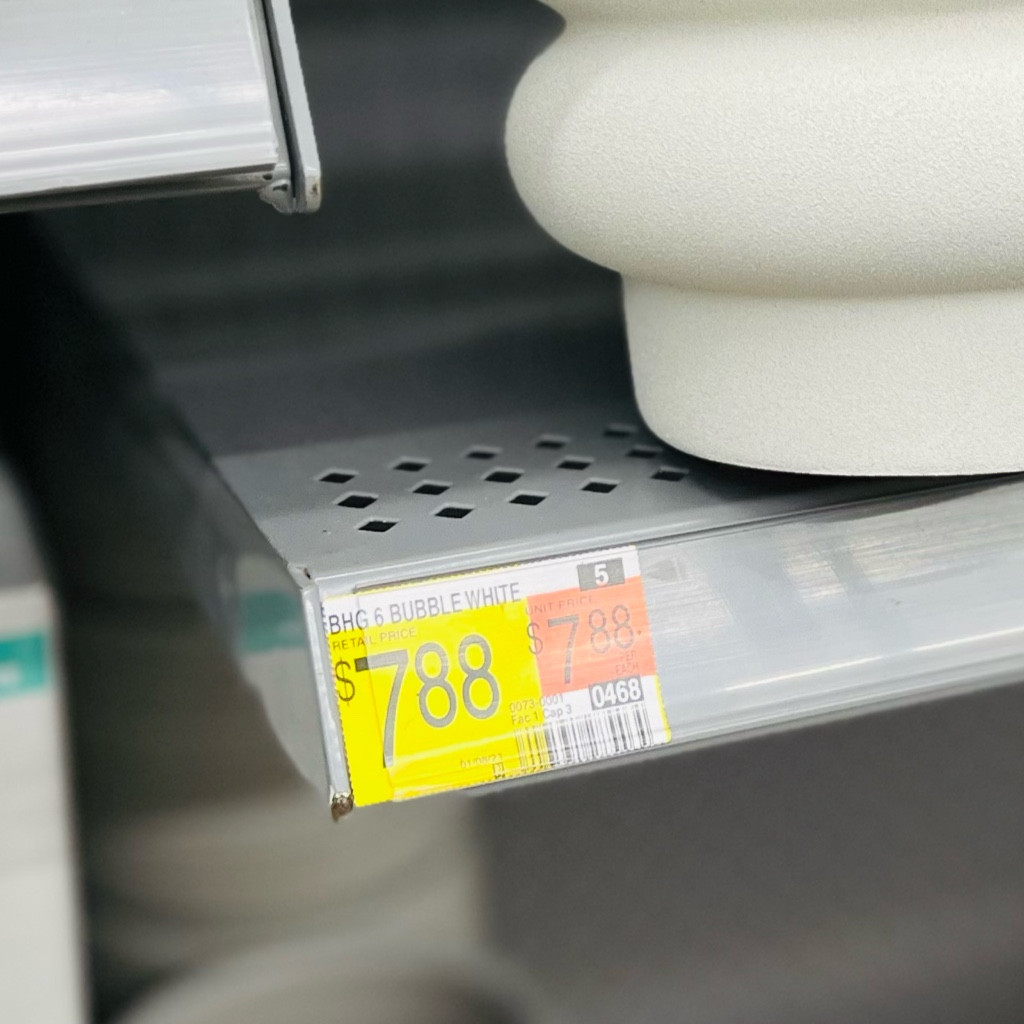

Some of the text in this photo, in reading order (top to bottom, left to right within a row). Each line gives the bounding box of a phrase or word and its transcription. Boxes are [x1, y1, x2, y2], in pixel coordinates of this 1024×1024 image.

[594, 563, 610, 586] 5
[328, 581, 522, 636] BHG 6 BUBBLE WHITE
[525, 602, 556, 616] UNIT
[332, 627, 417, 651] RETAIL PRICE
[591, 677, 642, 709] 0468
[510, 713, 531, 726] Fac
[541, 706, 564, 719] Cap
[565, 703, 573, 716] 3
